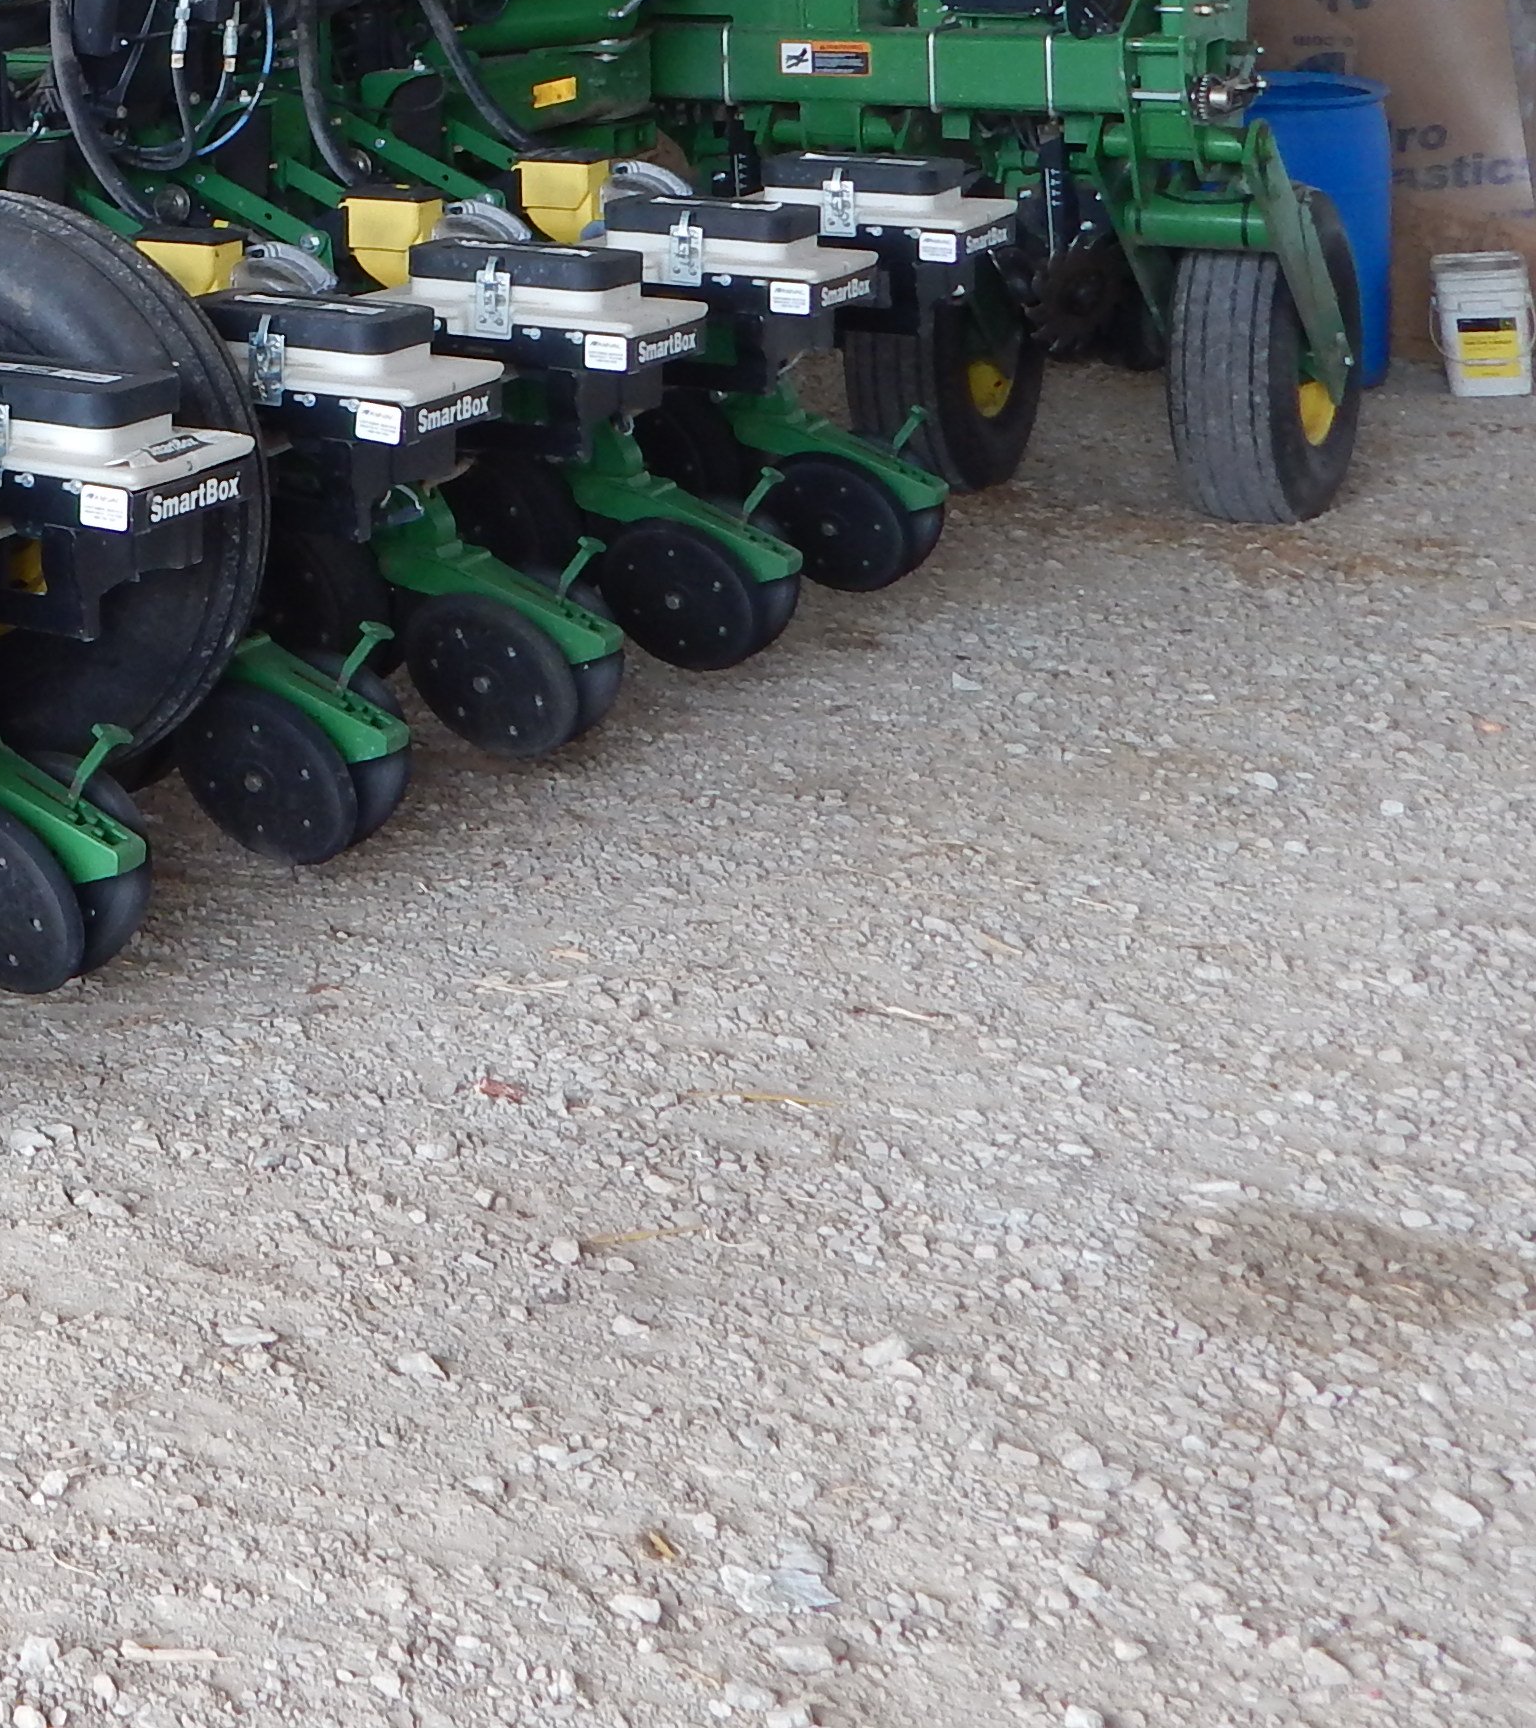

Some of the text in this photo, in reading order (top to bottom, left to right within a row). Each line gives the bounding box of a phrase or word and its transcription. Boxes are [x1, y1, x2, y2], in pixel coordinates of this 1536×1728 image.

[820, 278, 871, 307] SmartBox
[638, 331, 697, 363] SmartBox
[417, 395, 490, 434] SmartBox
[150, 475, 240, 523] SmartBox
